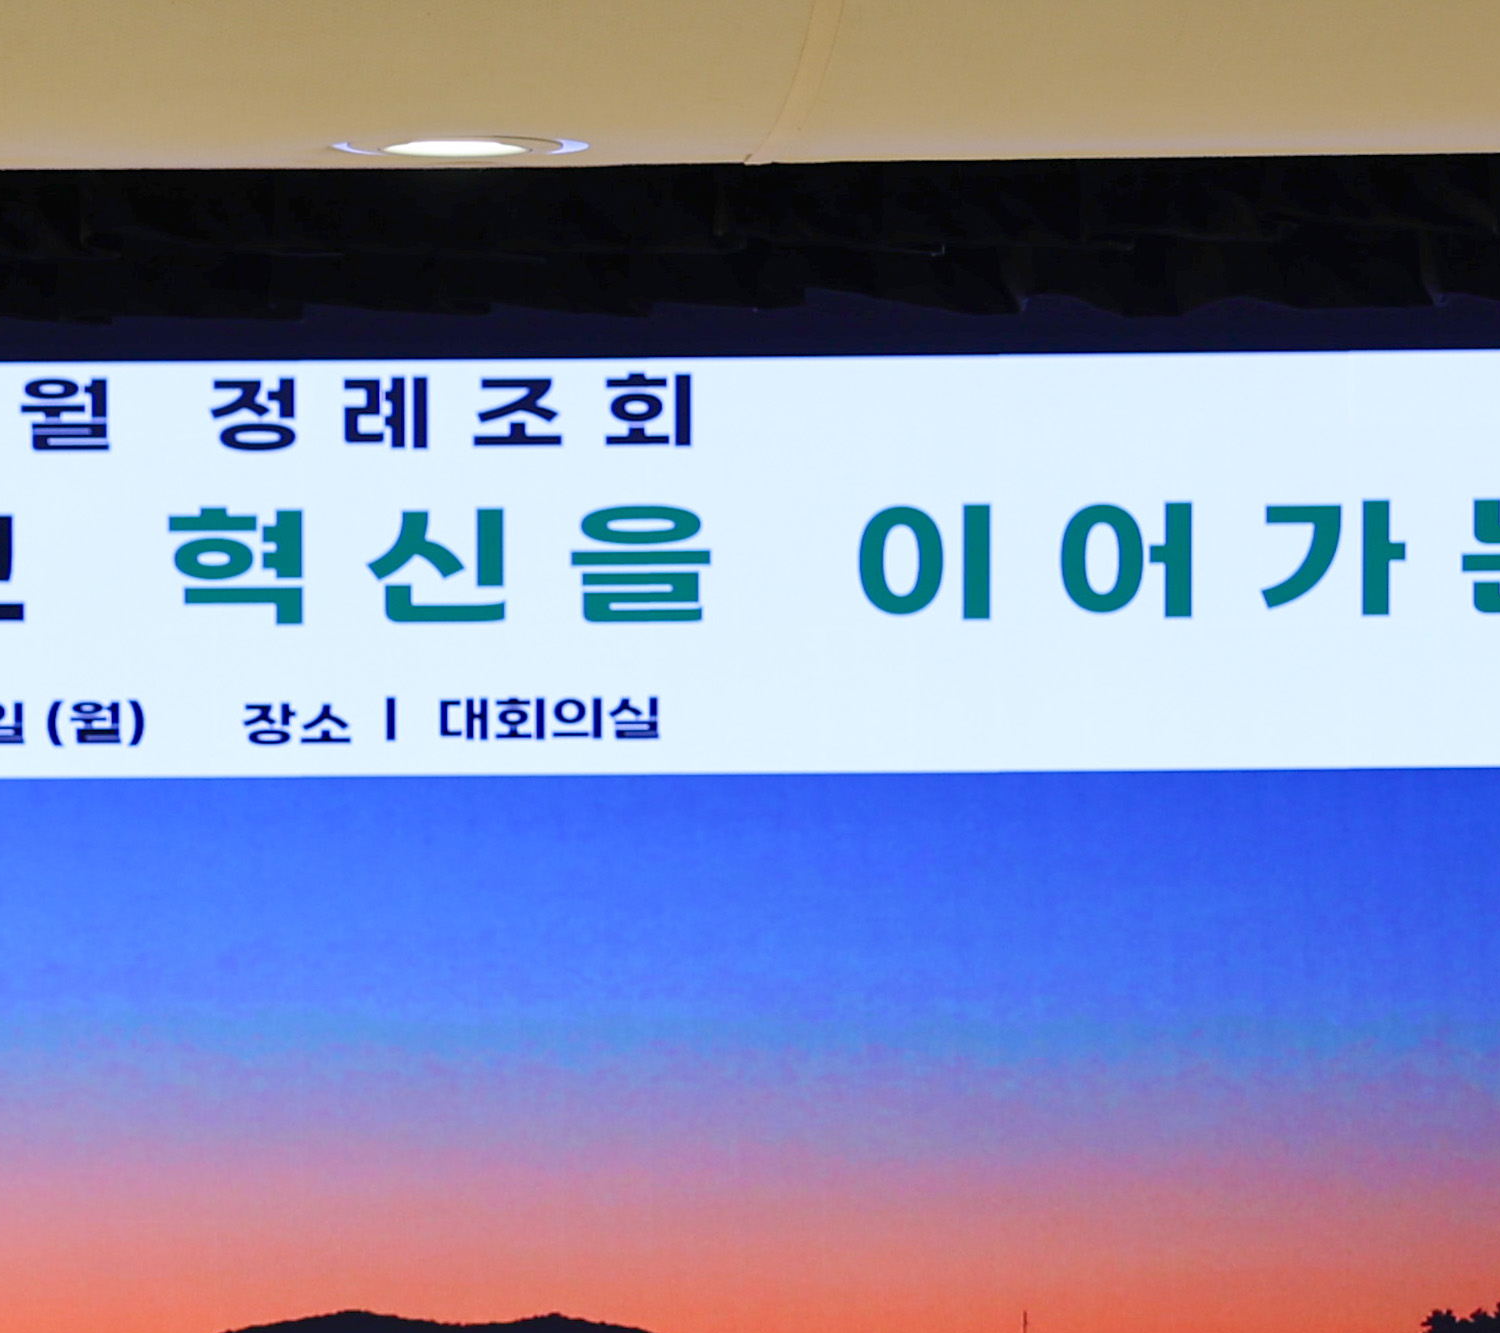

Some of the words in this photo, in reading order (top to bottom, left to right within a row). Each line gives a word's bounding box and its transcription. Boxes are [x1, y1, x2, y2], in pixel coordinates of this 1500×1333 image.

[210, 372, 694, 452] 정례조회
[168, 504, 712, 626] 혁신을
[243, 702, 352, 747] 장소
[438, 696, 661, 742] 대회의실
